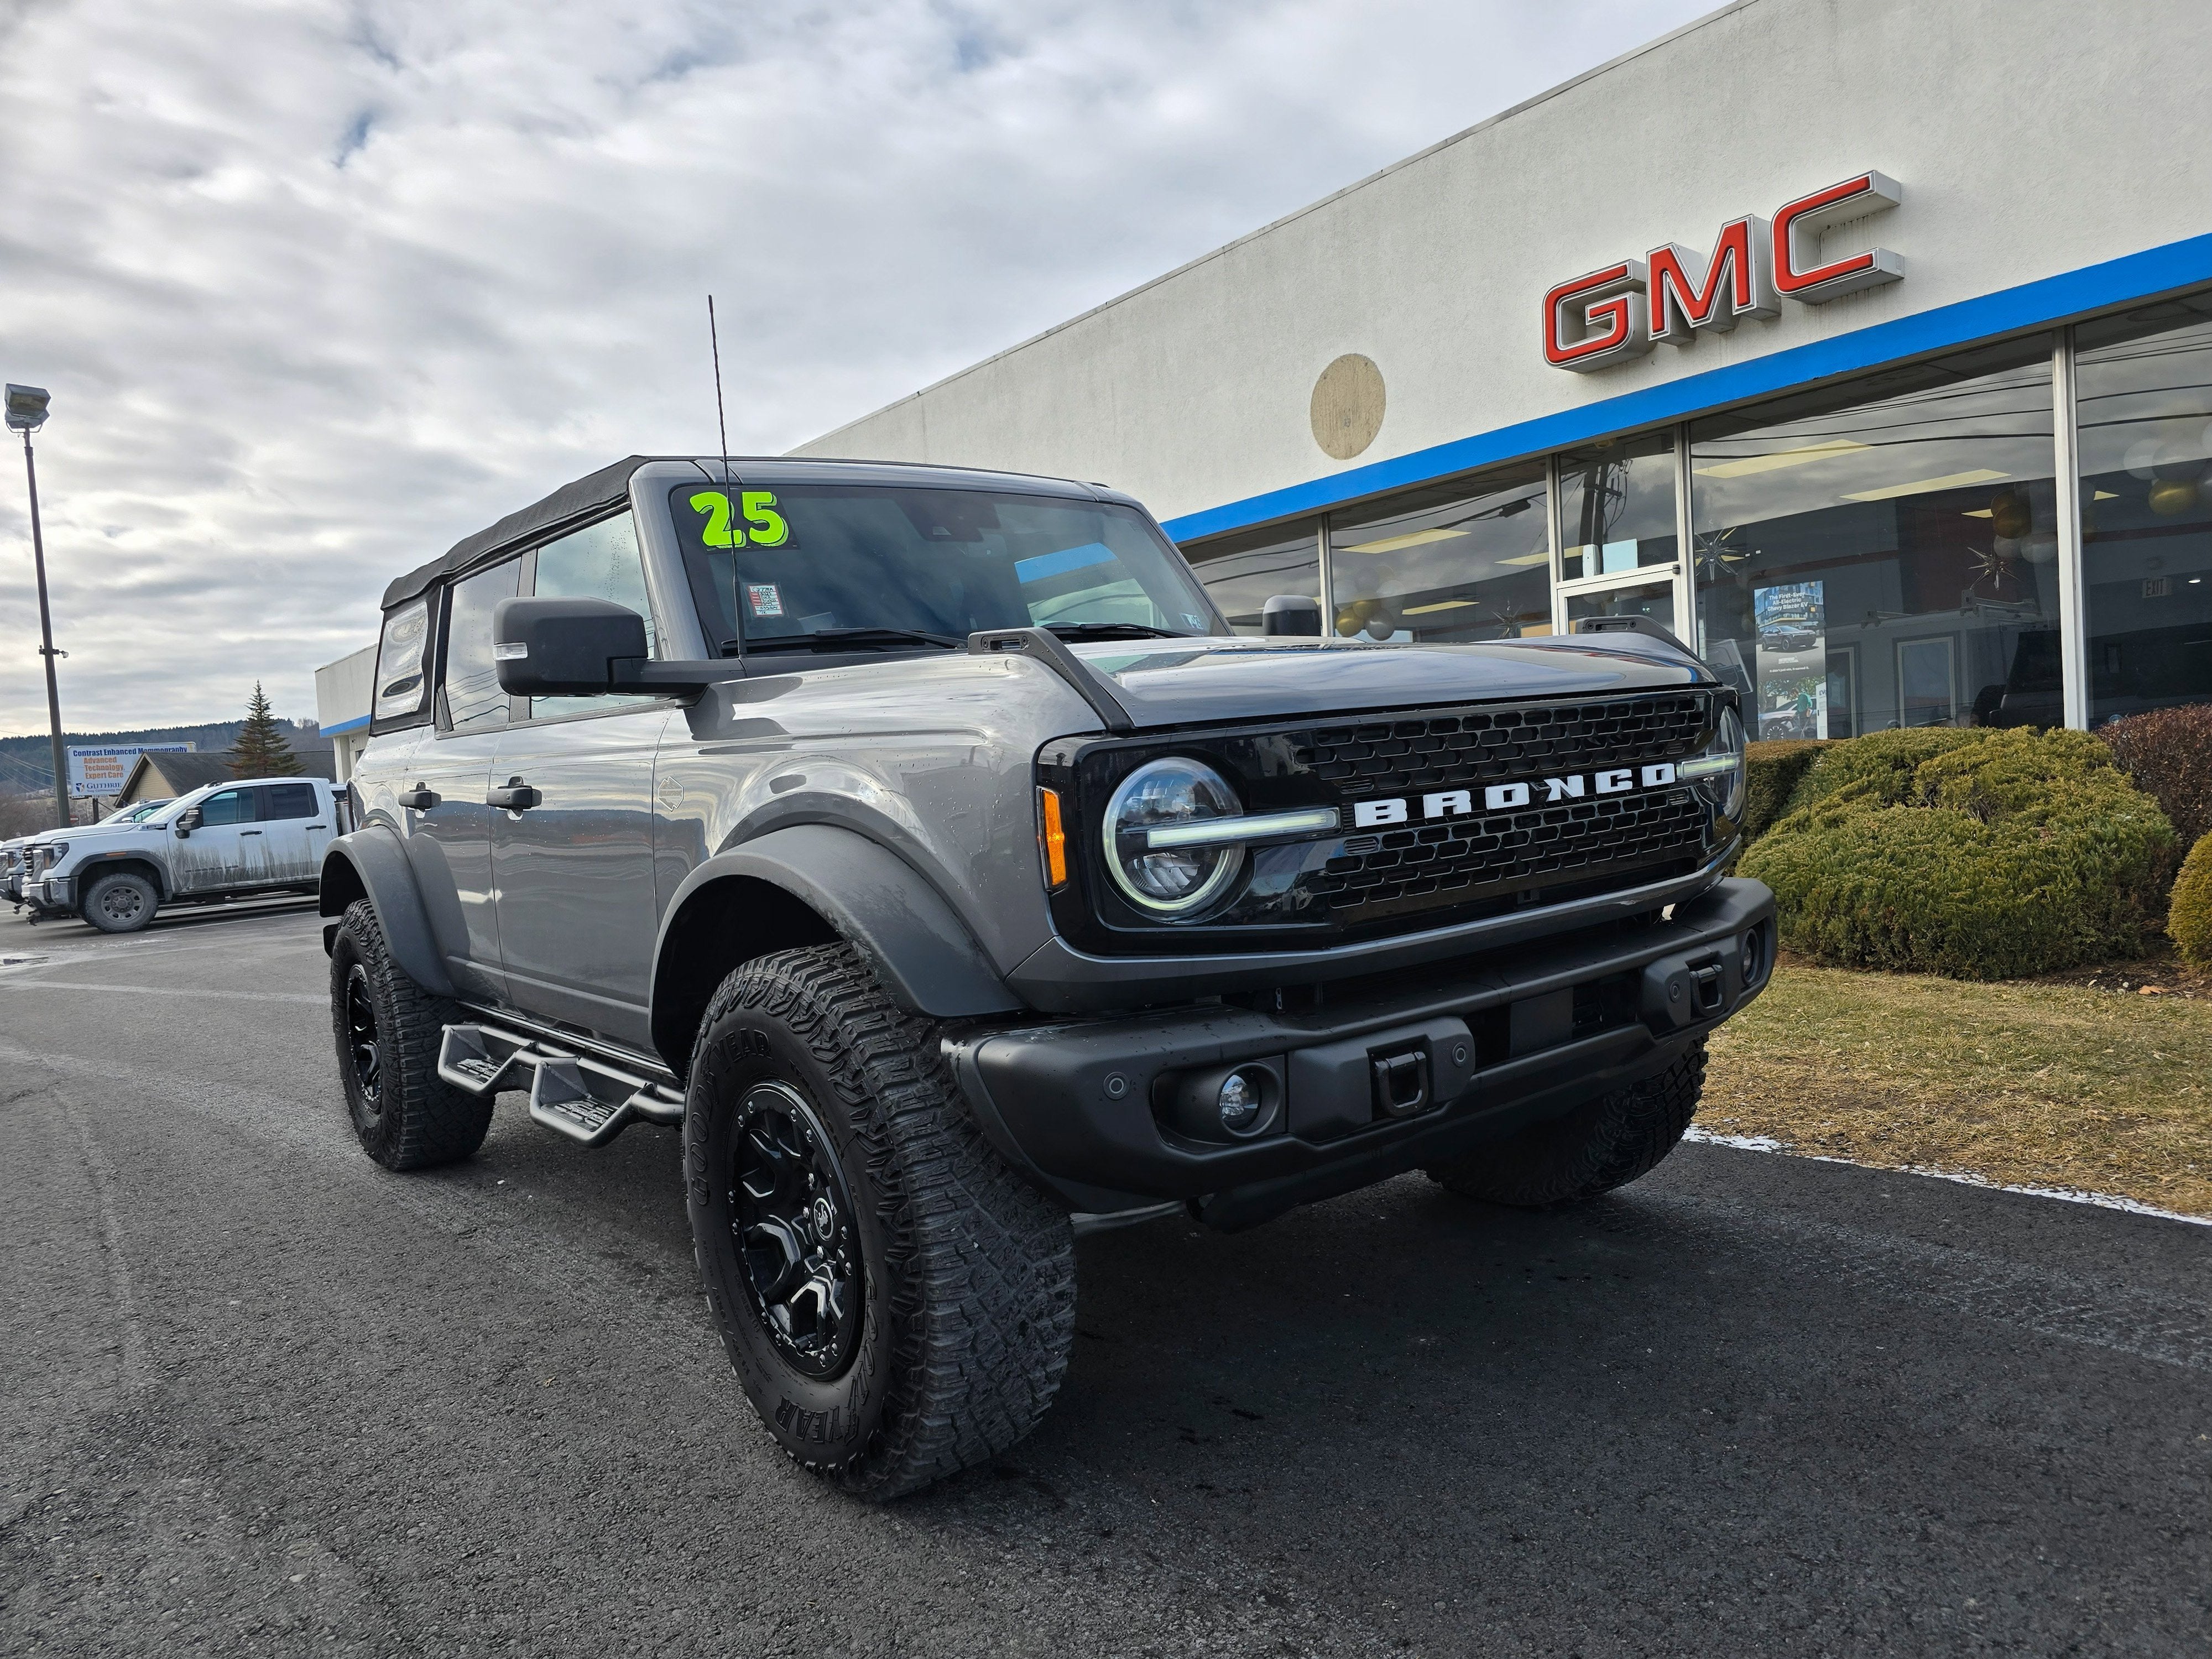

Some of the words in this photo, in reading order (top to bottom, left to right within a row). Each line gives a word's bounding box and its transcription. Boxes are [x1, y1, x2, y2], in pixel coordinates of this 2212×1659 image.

[1543, 170, 1903, 373] GMC
[690, 492, 789, 549] 25
[2146, 578, 2164, 596] EXIT
[73, 749, 102, 757] Contrast
[103, 747, 137, 756] Enhanced
[1353, 763, 1676, 828] BRONCO
[691, 1028, 773, 1206] GOODYEAR
[775, 1262, 878, 1446] GOODYEAR
